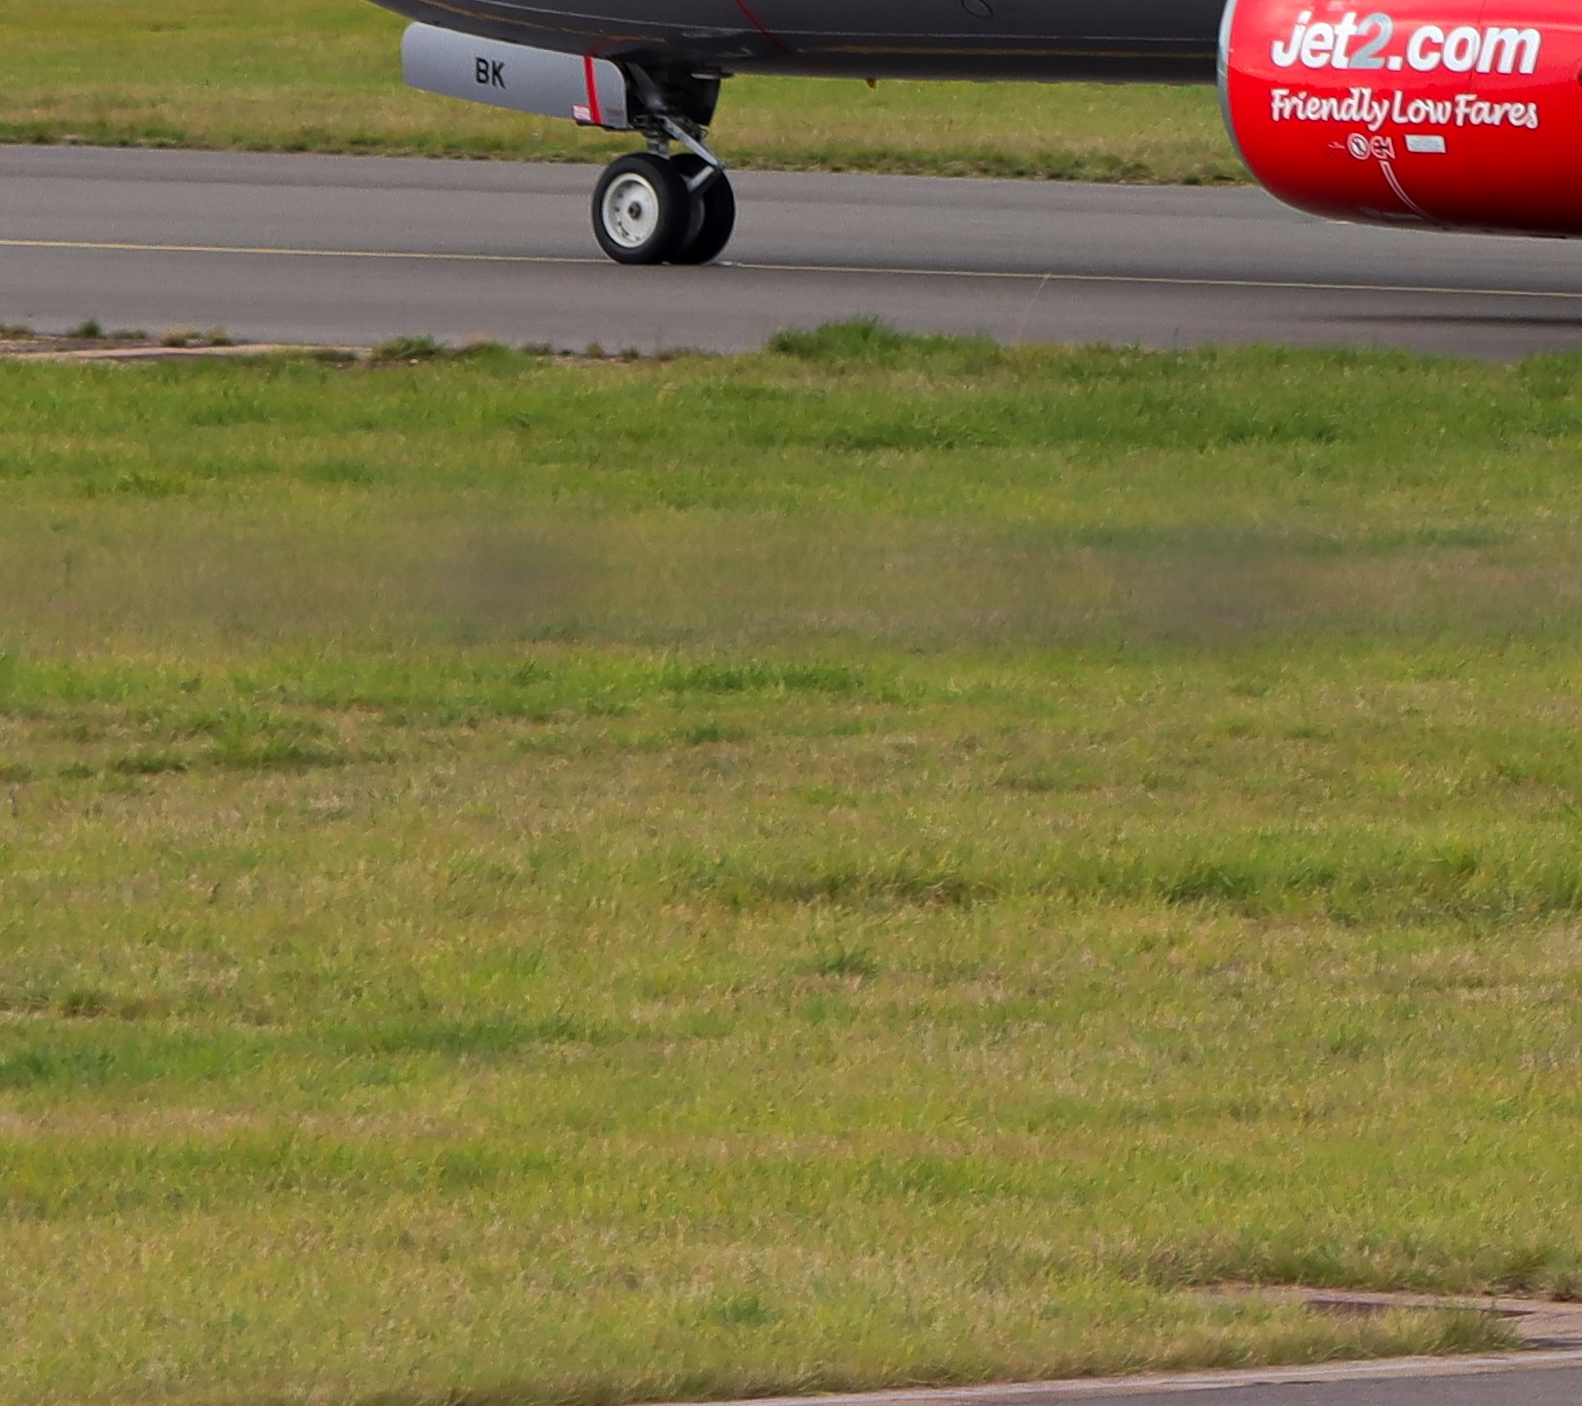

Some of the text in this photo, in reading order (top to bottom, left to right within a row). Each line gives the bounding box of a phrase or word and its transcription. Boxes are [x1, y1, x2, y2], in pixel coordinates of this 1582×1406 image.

[1270, 10, 1542, 74] jet2.com
[475, 57, 506, 89] BK
[1270, 88, 1539, 131] Friendly Low Fares
